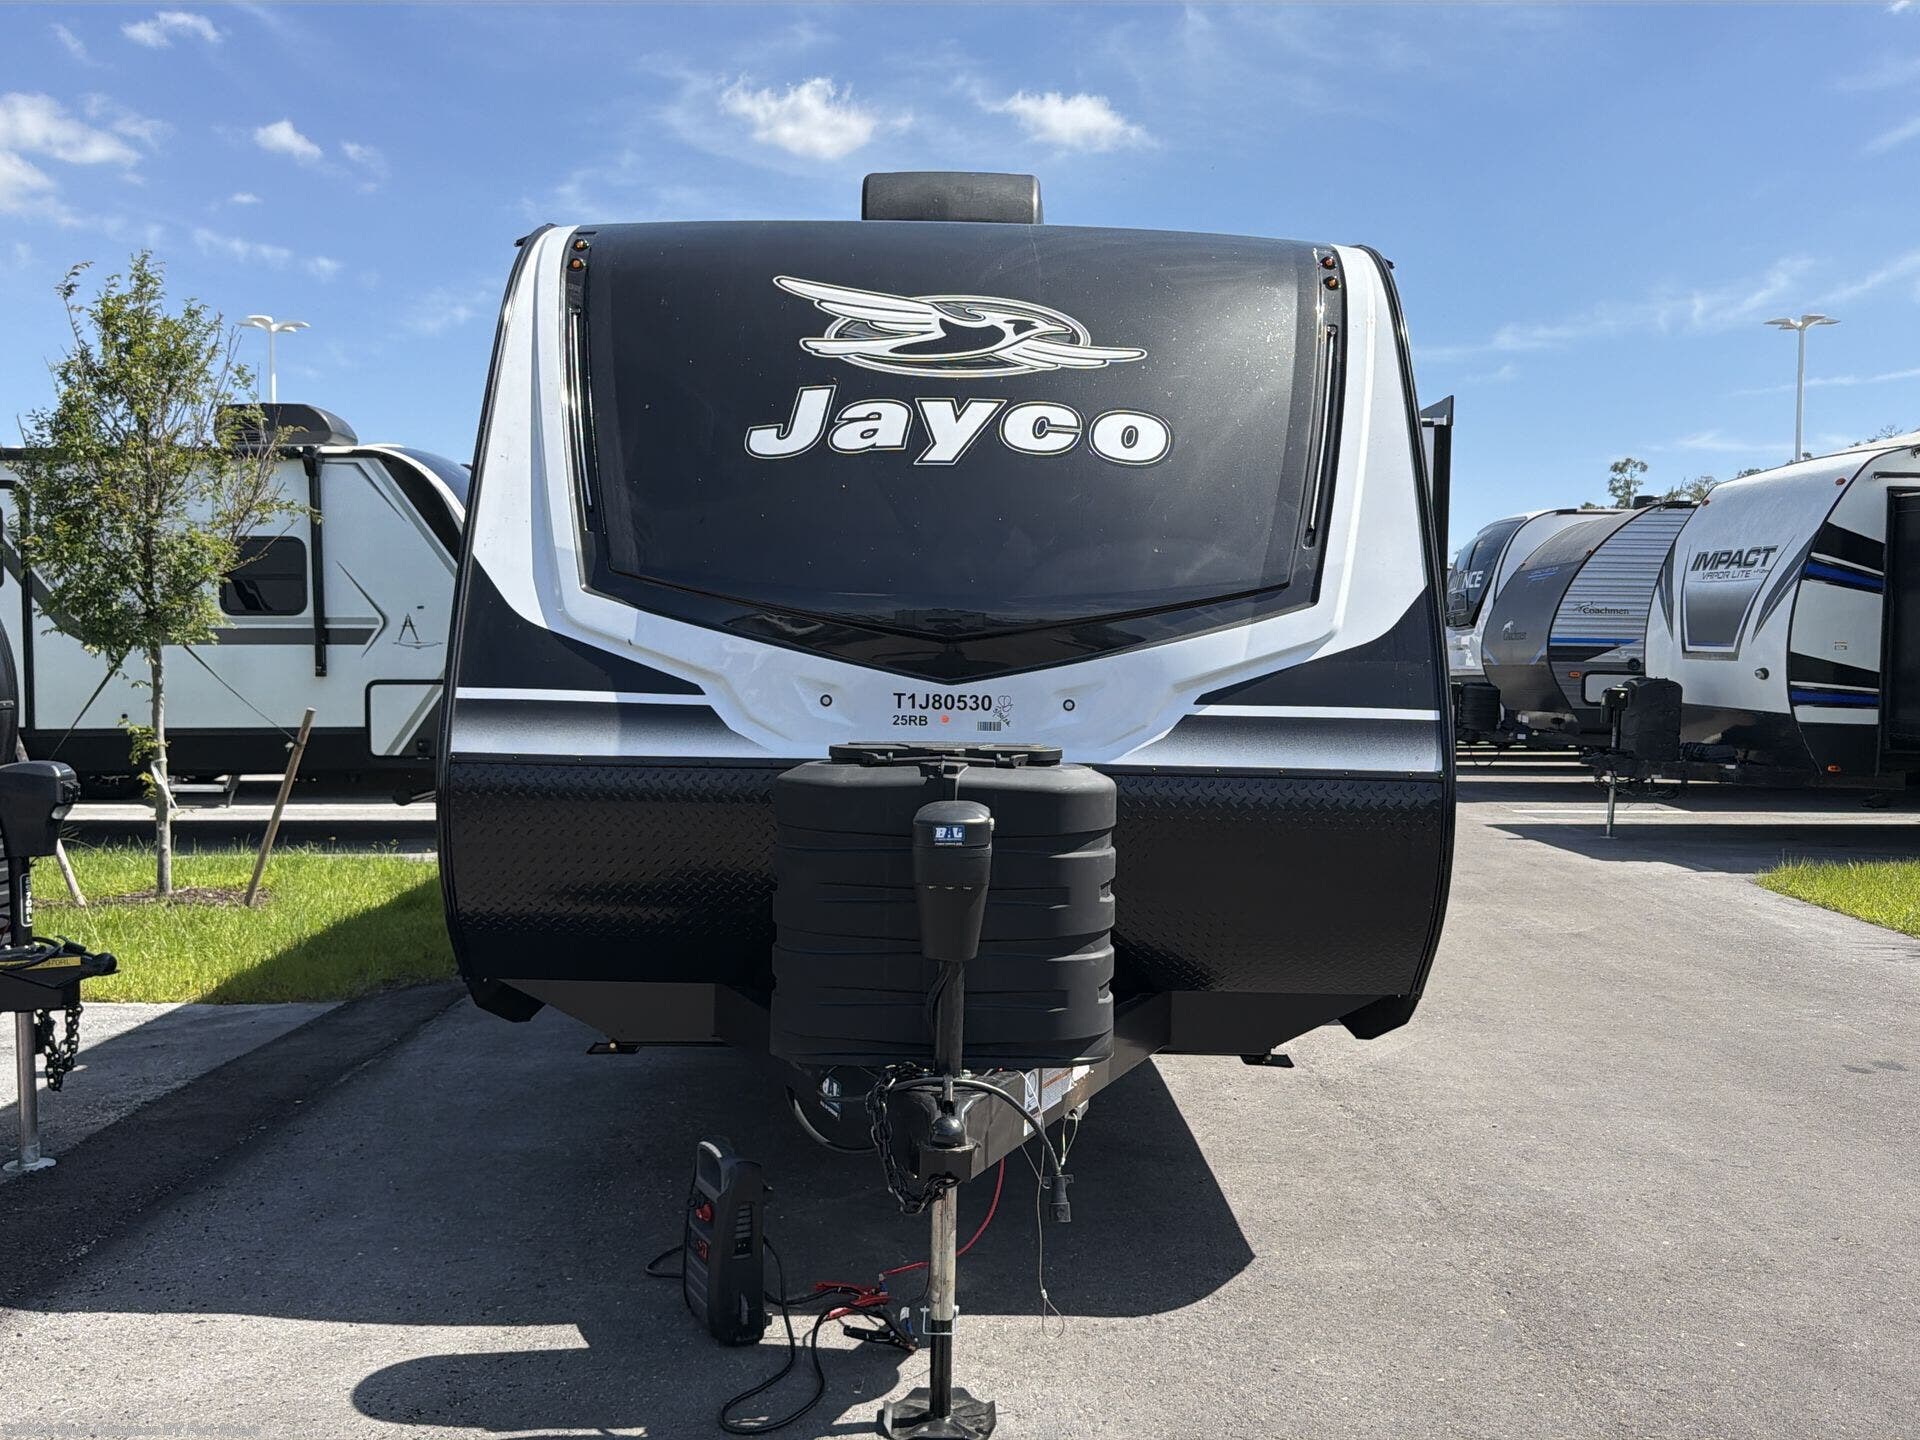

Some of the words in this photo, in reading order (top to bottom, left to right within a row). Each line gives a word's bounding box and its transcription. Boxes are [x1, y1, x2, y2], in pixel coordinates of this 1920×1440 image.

[744, 385, 1173, 466] Jayco
[1691, 545, 1779, 571] IMPACT
[1702, 570, 1730, 580] VAPOR
[1731, 569, 1752, 578] LITE
[1583, 606, 1630, 615] Coachmen
[893, 692, 993, 711] T1J80530
[892, 714, 928, 726] 25RB
